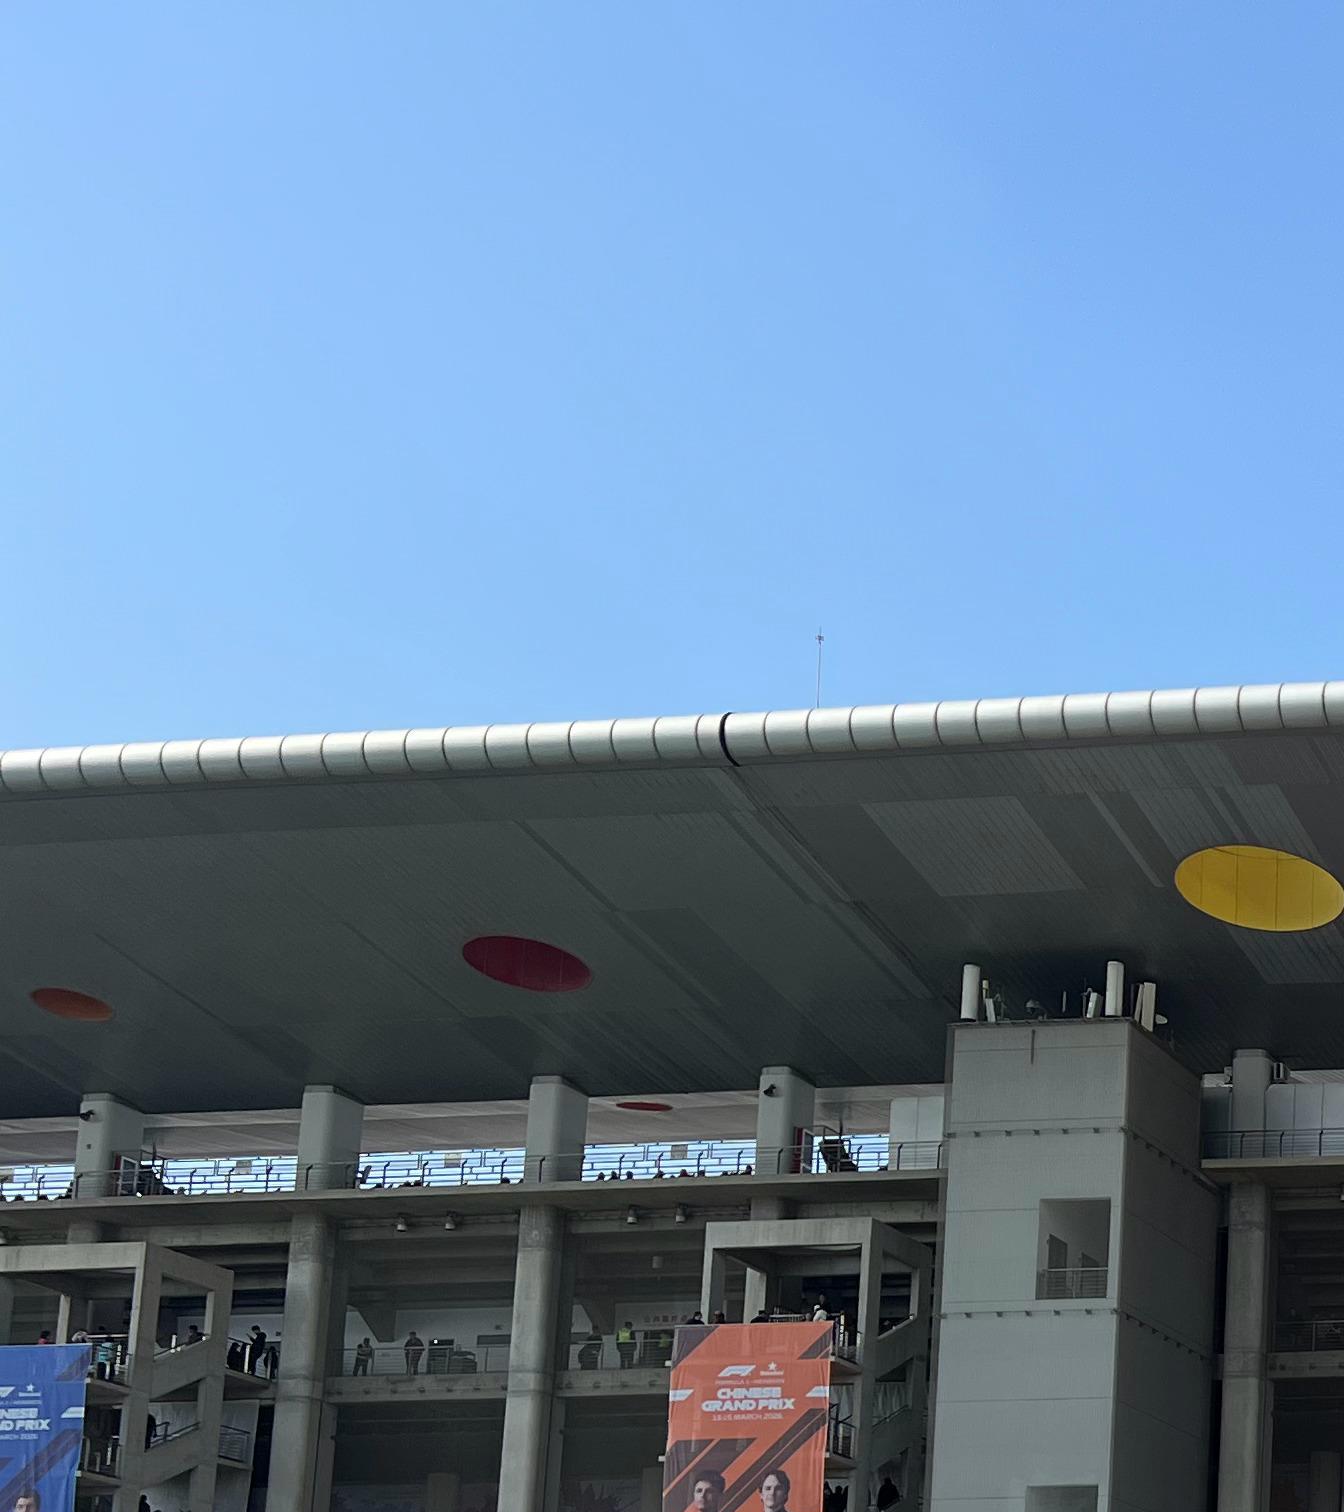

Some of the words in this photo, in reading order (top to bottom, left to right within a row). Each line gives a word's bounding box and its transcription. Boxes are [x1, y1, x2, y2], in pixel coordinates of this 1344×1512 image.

[716, 1387, 782, 1400] CHINESE
[701, 1399, 757, 1412] GRAND
[757, 1398, 797, 1411] PRIX
